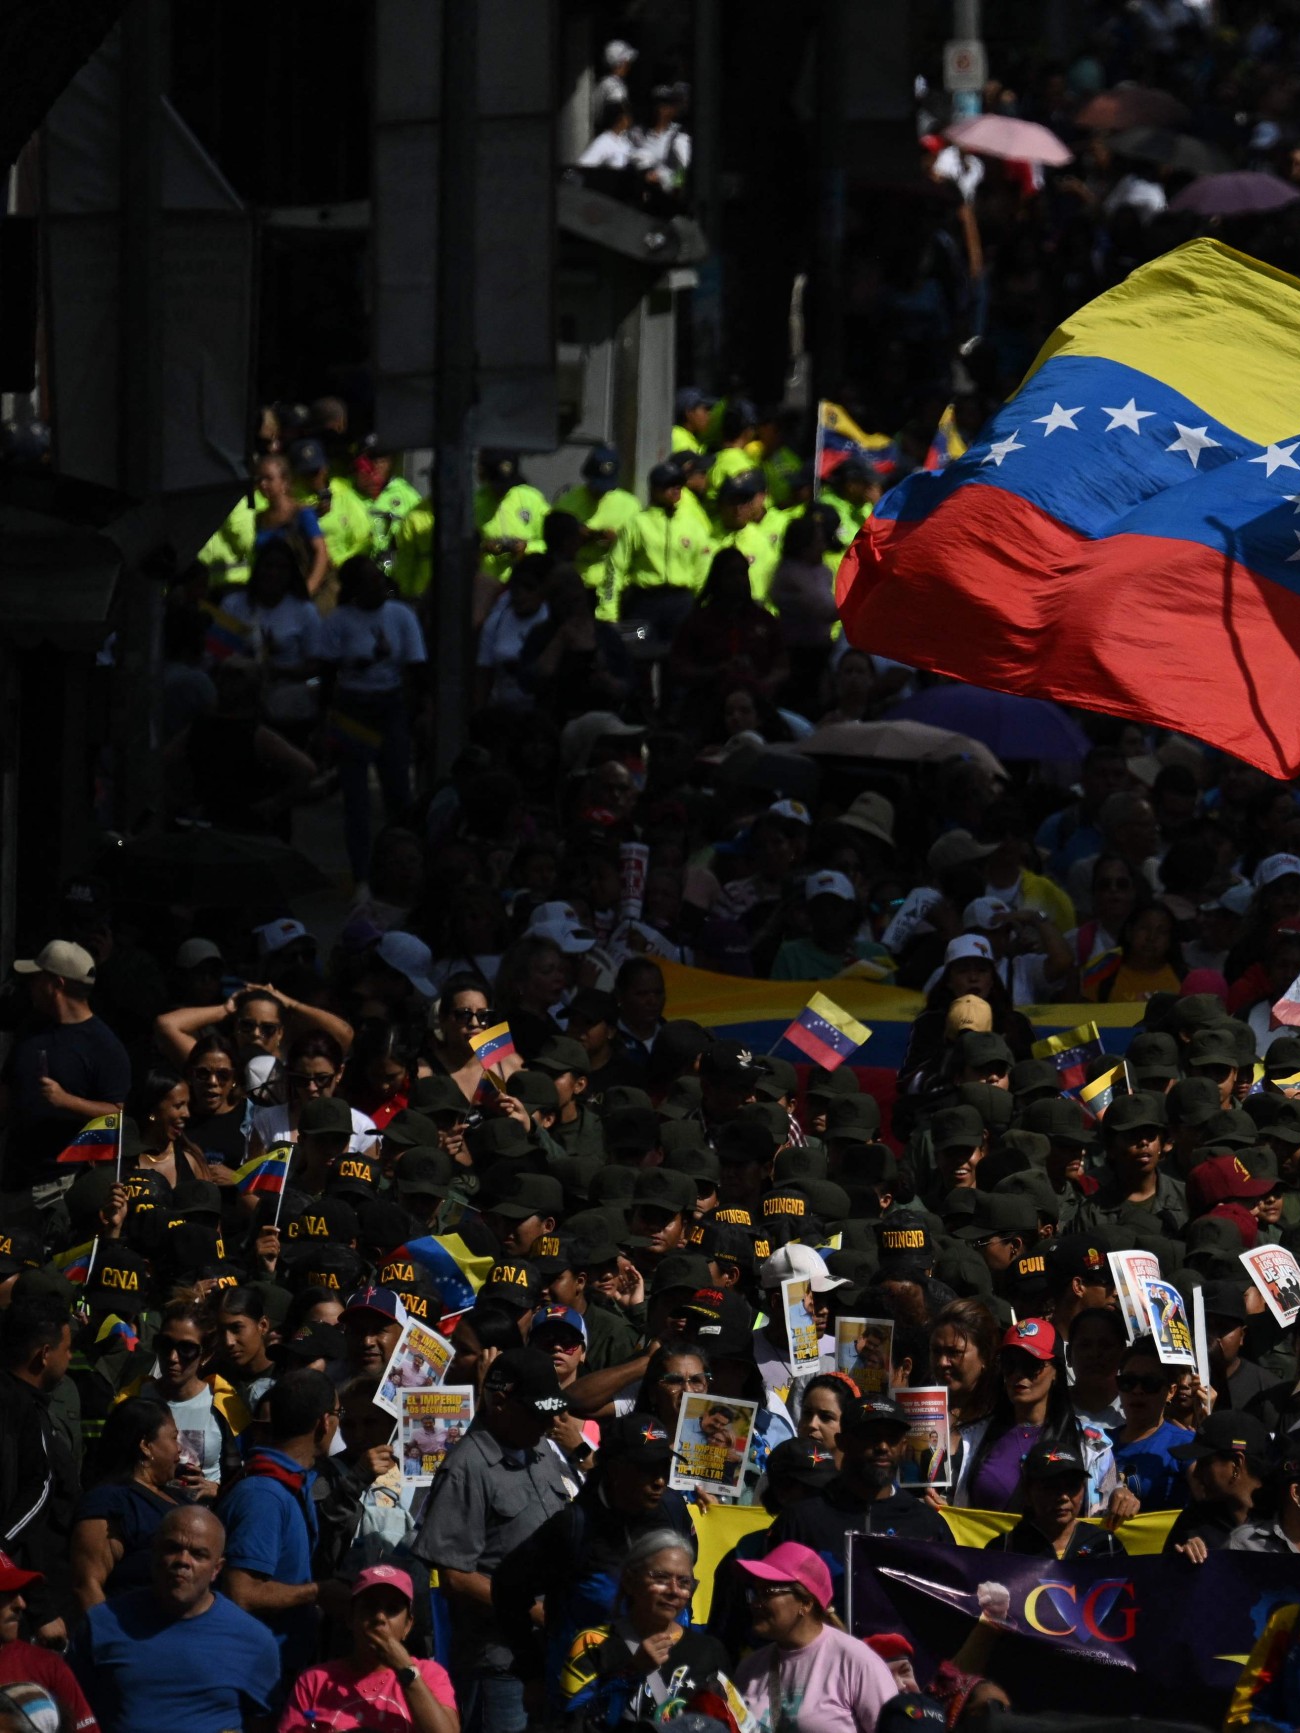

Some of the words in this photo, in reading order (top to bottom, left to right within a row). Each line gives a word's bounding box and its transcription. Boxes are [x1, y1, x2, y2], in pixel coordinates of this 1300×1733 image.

[339, 1159, 373, 1183] CNA
[763, 1197, 805, 1217] CUINGNB
[883, 1230, 925, 1249] CUINGNB
[101, 1266, 140, 1291] CNA
[381, 1263, 415, 1285] CNA
[491, 1266, 529, 1288] CNA
[407, 1395, 418, 1405] EL
[420, 1394, 462, 1407] IMPERIO
[690, 1466, 724, 1480] VUELTA!
